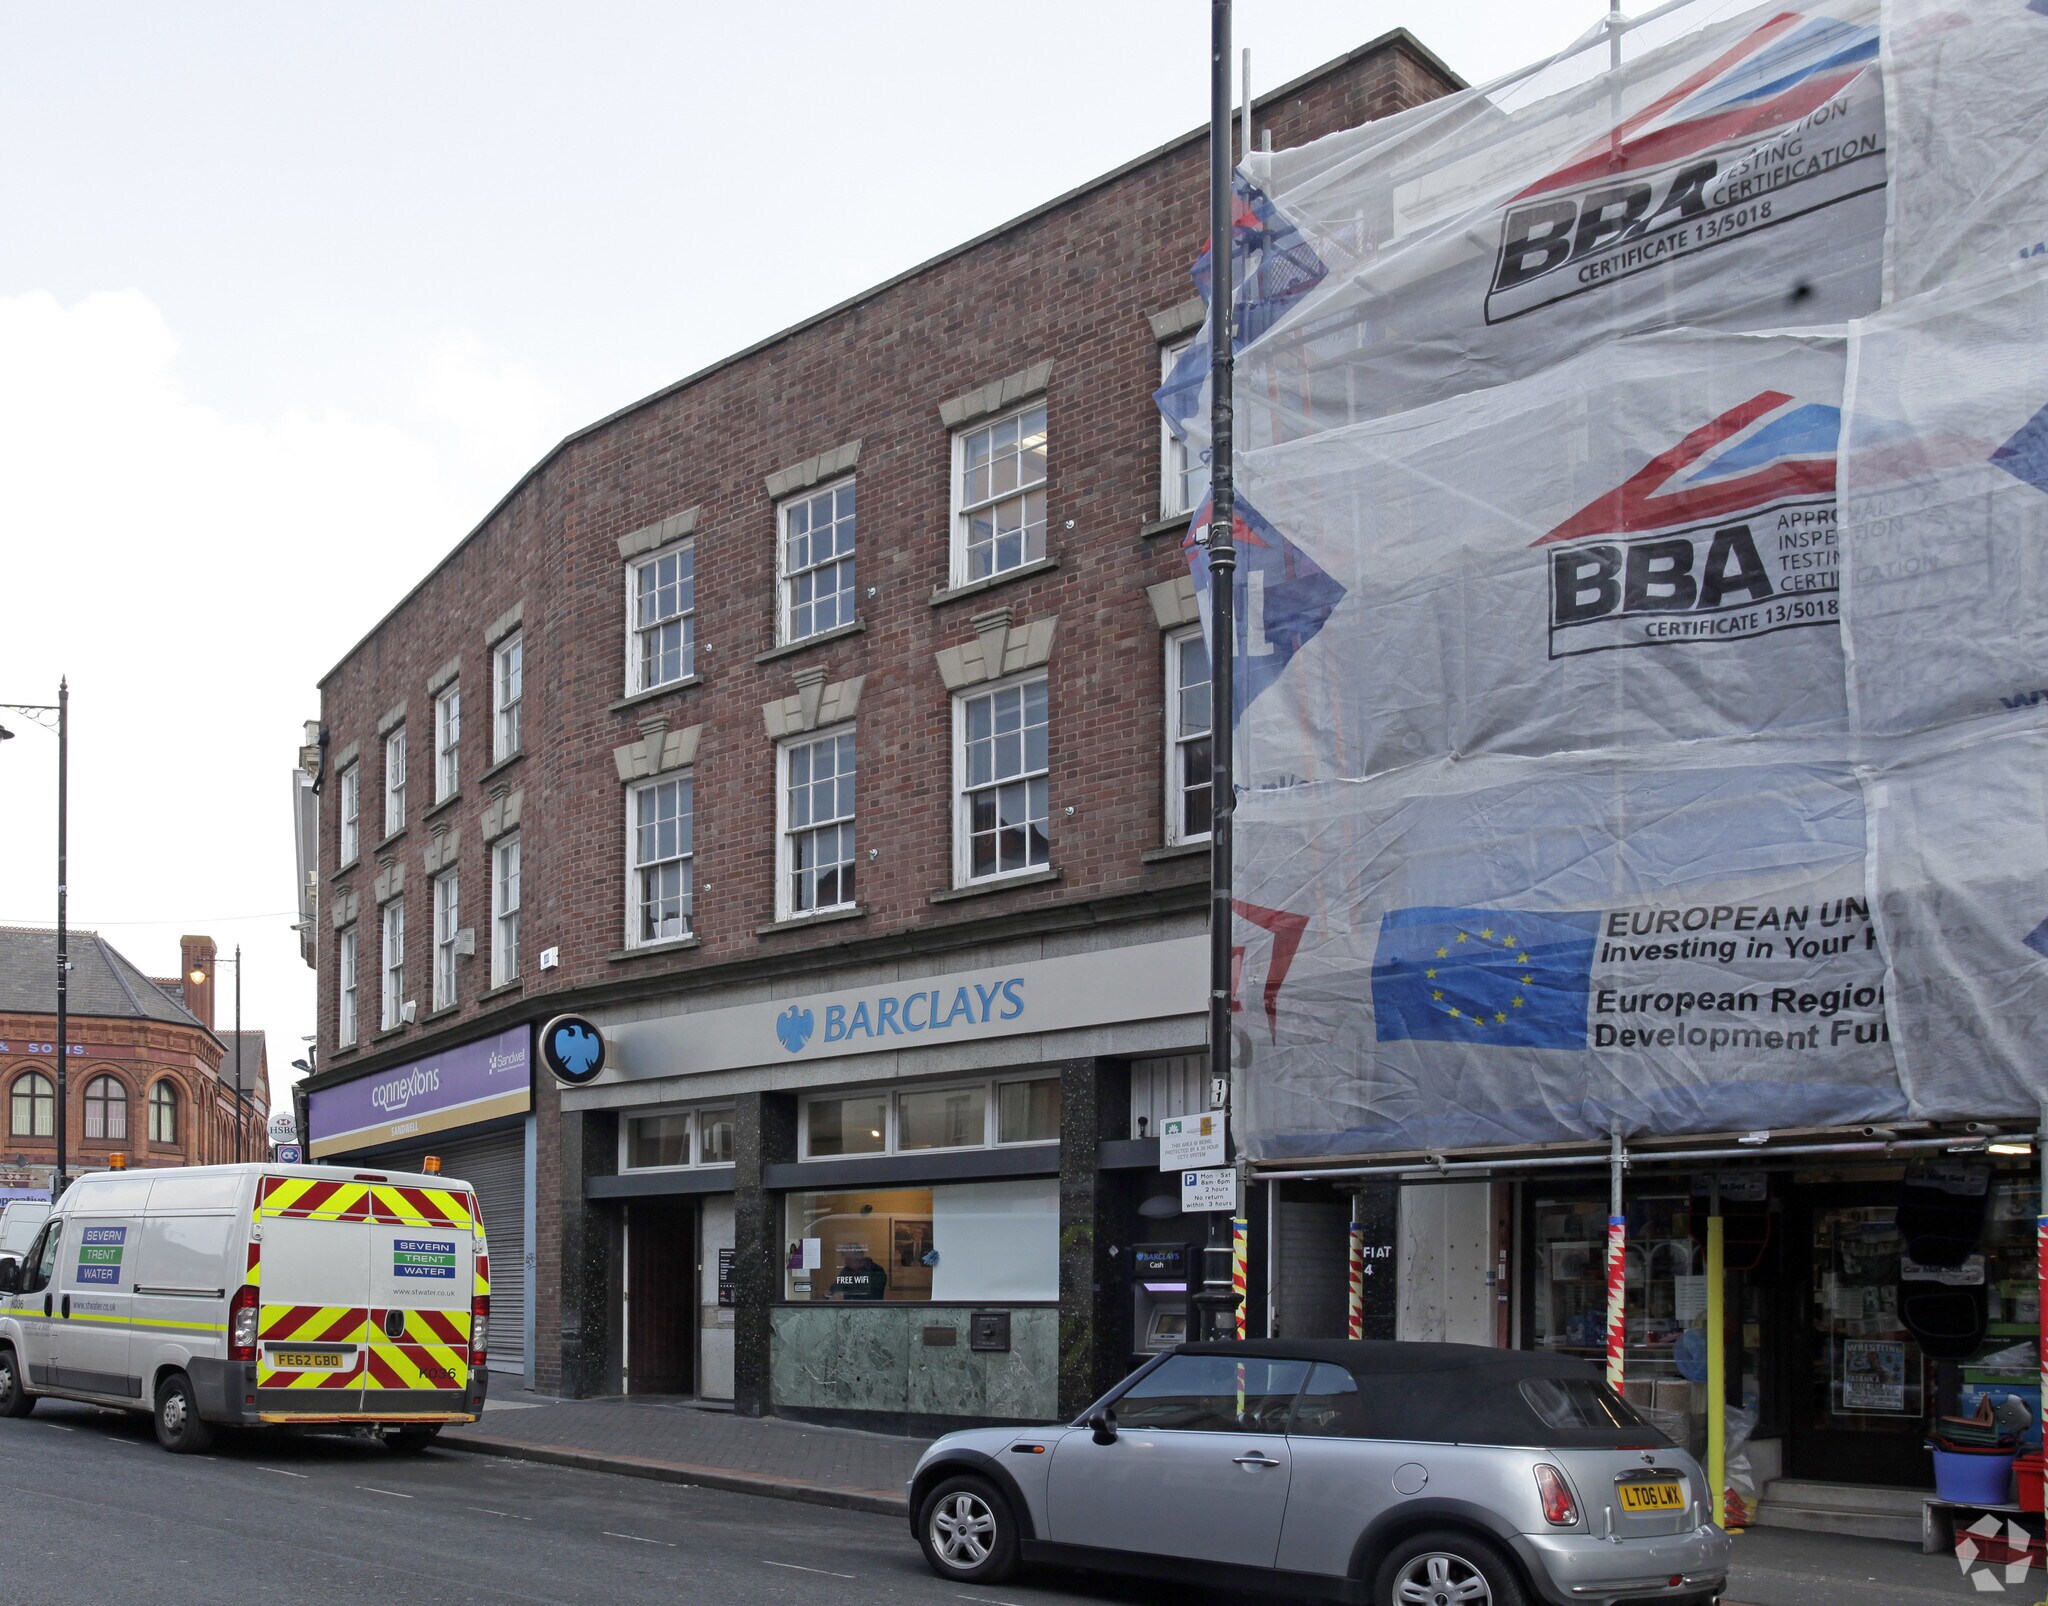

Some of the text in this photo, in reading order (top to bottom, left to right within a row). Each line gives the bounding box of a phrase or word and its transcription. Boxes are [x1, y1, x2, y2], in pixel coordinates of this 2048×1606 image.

[1713, 133, 1876, 205] CERTIFICATION
[1495, 159, 1718, 290] BBA
[1578, 201, 1772, 284] CERTIFICATE 13/5018
[1554, 524, 1774, 625] BBA
[1645, 600, 1839, 638] CERTIFICATE 13/5018
[1606, 905, 1809, 937] EUROPEAN
[1600, 936, 1737, 964] Investing
[1746, 937, 1773, 958] in
[1784, 934, 1855, 959] Your
[1596, 989, 1758, 1017] European
[824, 978, 1025, 1043] BARCLAYS
[1595, 1022, 1820, 1052] Development
[372, 1067, 440, 1111] connexions
[270, 1126, 297, 1134] HSBC
[391, 1121, 419, 1137] SANDWELL
[86, 1231, 122, 1240] SEVERN
[400, 1242, 450, 1251] SEVERN
[1363, 1246, 1392, 1258] FIAT
[87, 1250, 115, 1259] TRENT
[405, 1254, 445, 1263] TRENT
[1144, 1252, 1180, 1261] BARCLAYS
[84, 1269, 113, 1279] WATER
[404, 1267, 446, 1276] WATER
[1364, 1264, 1373, 1275] 4
[836, 1276, 853, 1284] FREE
[393, 1288, 456, 1297] www.stwater.co.uk
[278, 1354, 339, 1366] FE62 GBO
[419, 1367, 457, 1380] K036
[1624, 1485, 1681, 1507] LT06 LWX
